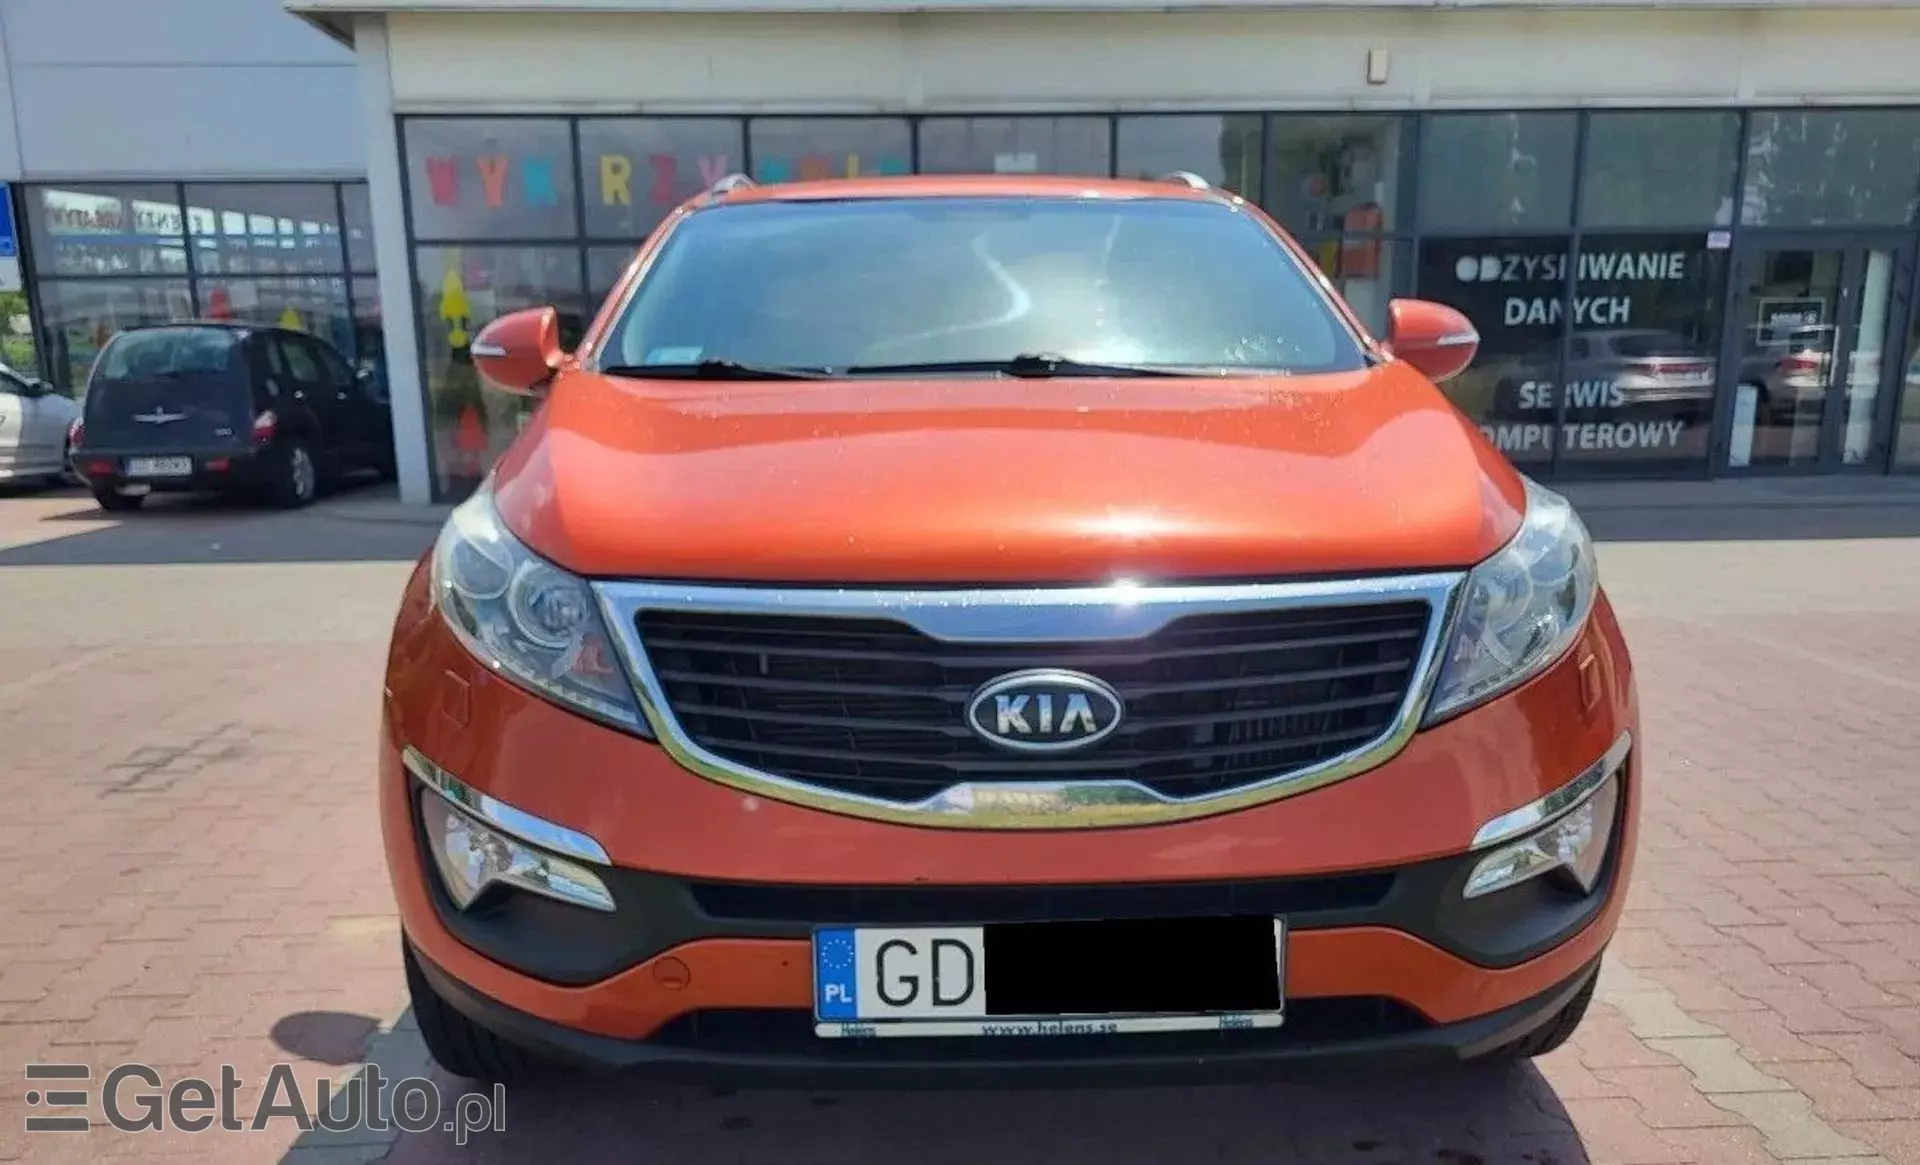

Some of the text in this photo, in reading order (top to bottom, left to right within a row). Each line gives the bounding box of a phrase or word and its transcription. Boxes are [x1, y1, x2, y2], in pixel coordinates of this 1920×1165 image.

[1455, 252, 1687, 283] ODZYSIWANIE
[1518, 380, 1626, 410] SEWIS
[995, 694, 1097, 733] KIA
[875, 938, 975, 1007] GD
[824, 983, 852, 1002] PL
[981, 1019, 1119, 1036] www.helens.se
